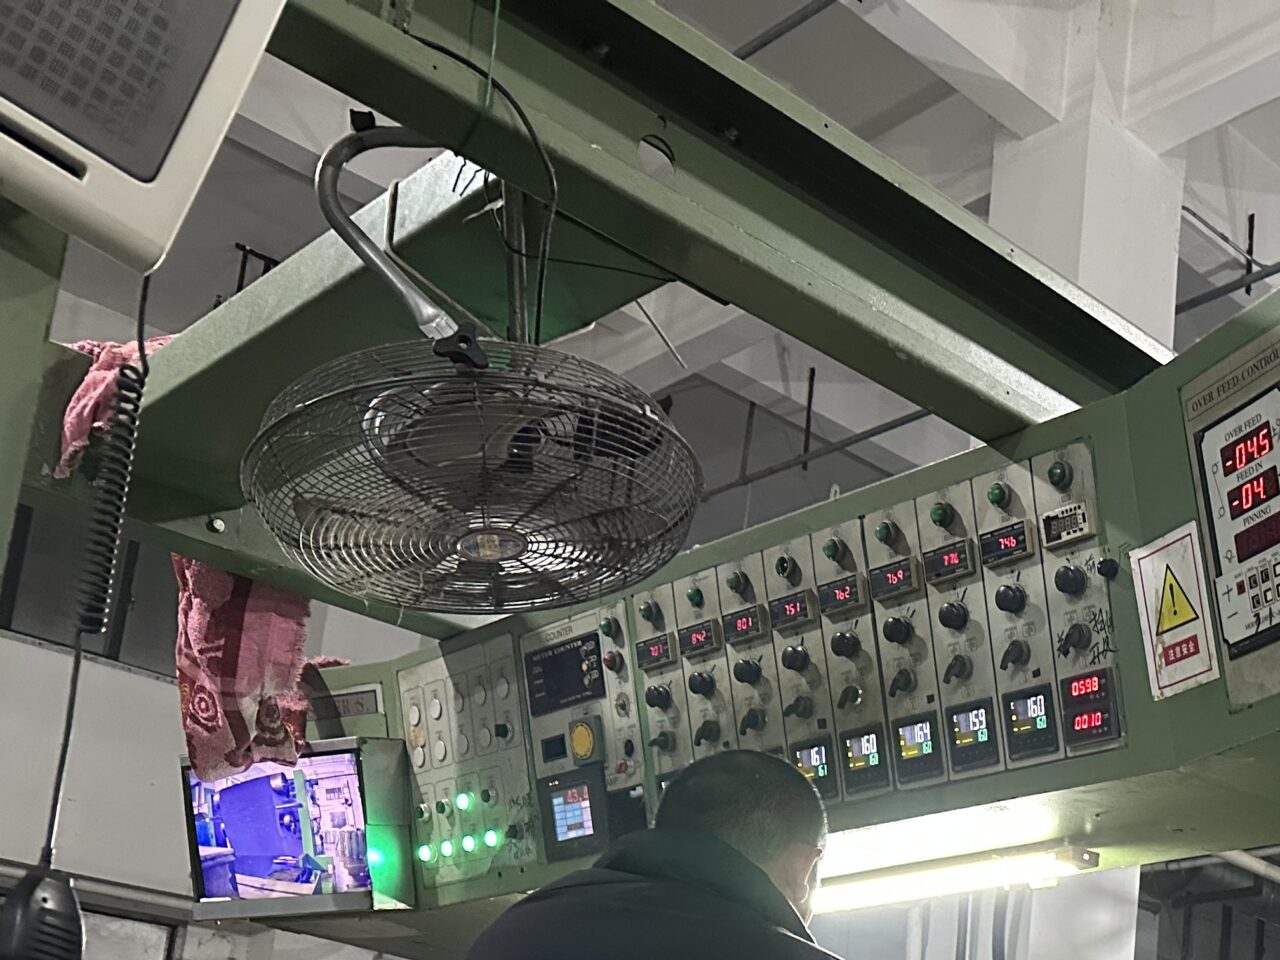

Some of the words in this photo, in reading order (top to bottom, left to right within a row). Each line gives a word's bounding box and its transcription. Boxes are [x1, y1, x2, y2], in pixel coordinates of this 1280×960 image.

[1191, 391, 1215, 412] OVER
[1216, 375, 1239, 396] FEED
[1241, 349, 1280, 381] CONTROL
[1224, 425, 1244, 442] OVER
[1243, 414, 1262, 433] FEED
[1236, 465, 1255, 482] FEED
[1255, 461, 1263, 474] IN
[1242, 505, 1271, 527] PINNING
[785, 602, 800, 615] 751
[544, 625, 574, 642] COUNTER
[736, 617, 752, 631] 801
[553, 640, 583, 655] COUNTER
[1168, 640, 1195, 661] 注意安全
[1071, 676, 1099, 696] 0598
[1027, 695, 1045, 718] 160
[969, 708, 986, 731] 159
[1074, 712, 1102, 731] 0010
[914, 721, 931, 743] 164
[861, 734, 877, 755] 160
[810, 745, 826, 766] 161
[818, 764, 828, 777] 61
